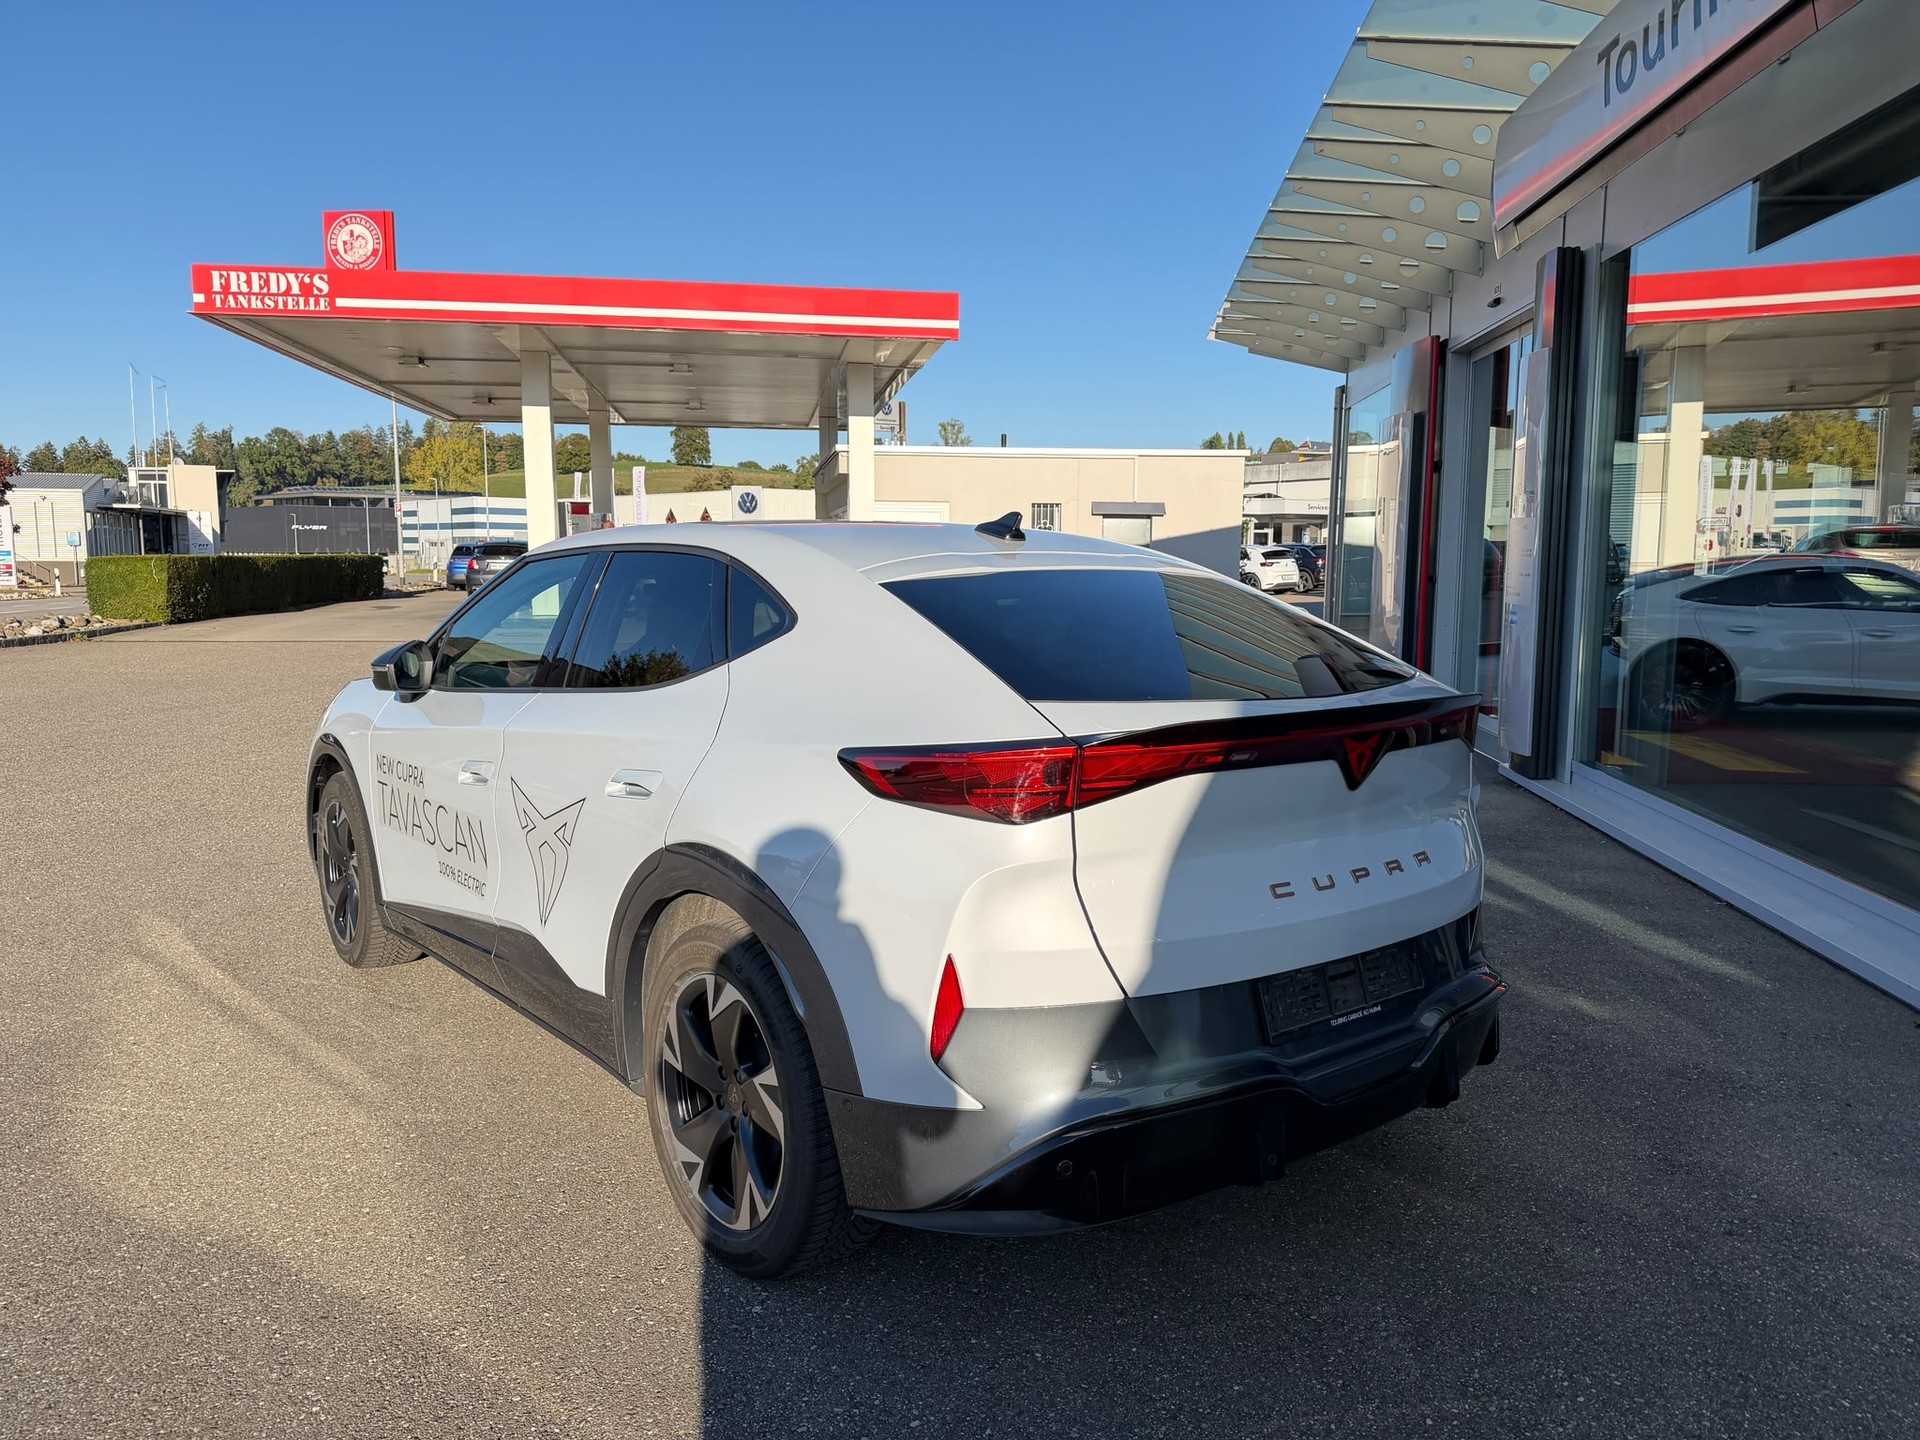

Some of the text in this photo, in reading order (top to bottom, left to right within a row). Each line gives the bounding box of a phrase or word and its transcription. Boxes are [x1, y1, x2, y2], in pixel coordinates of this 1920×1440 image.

[212, 294, 330, 311] TANKSTELLE
[376, 753, 425, 789] NEW CUPRA
[377, 780, 488, 869] TAVASCAN
[438, 860, 487, 897] 100% ELECTRIC
[1269, 850, 1432, 899] CUPRA
[1330, 1016, 1348, 1026] TOURING
[1348, 1010, 1363, 1021] GARAGE
